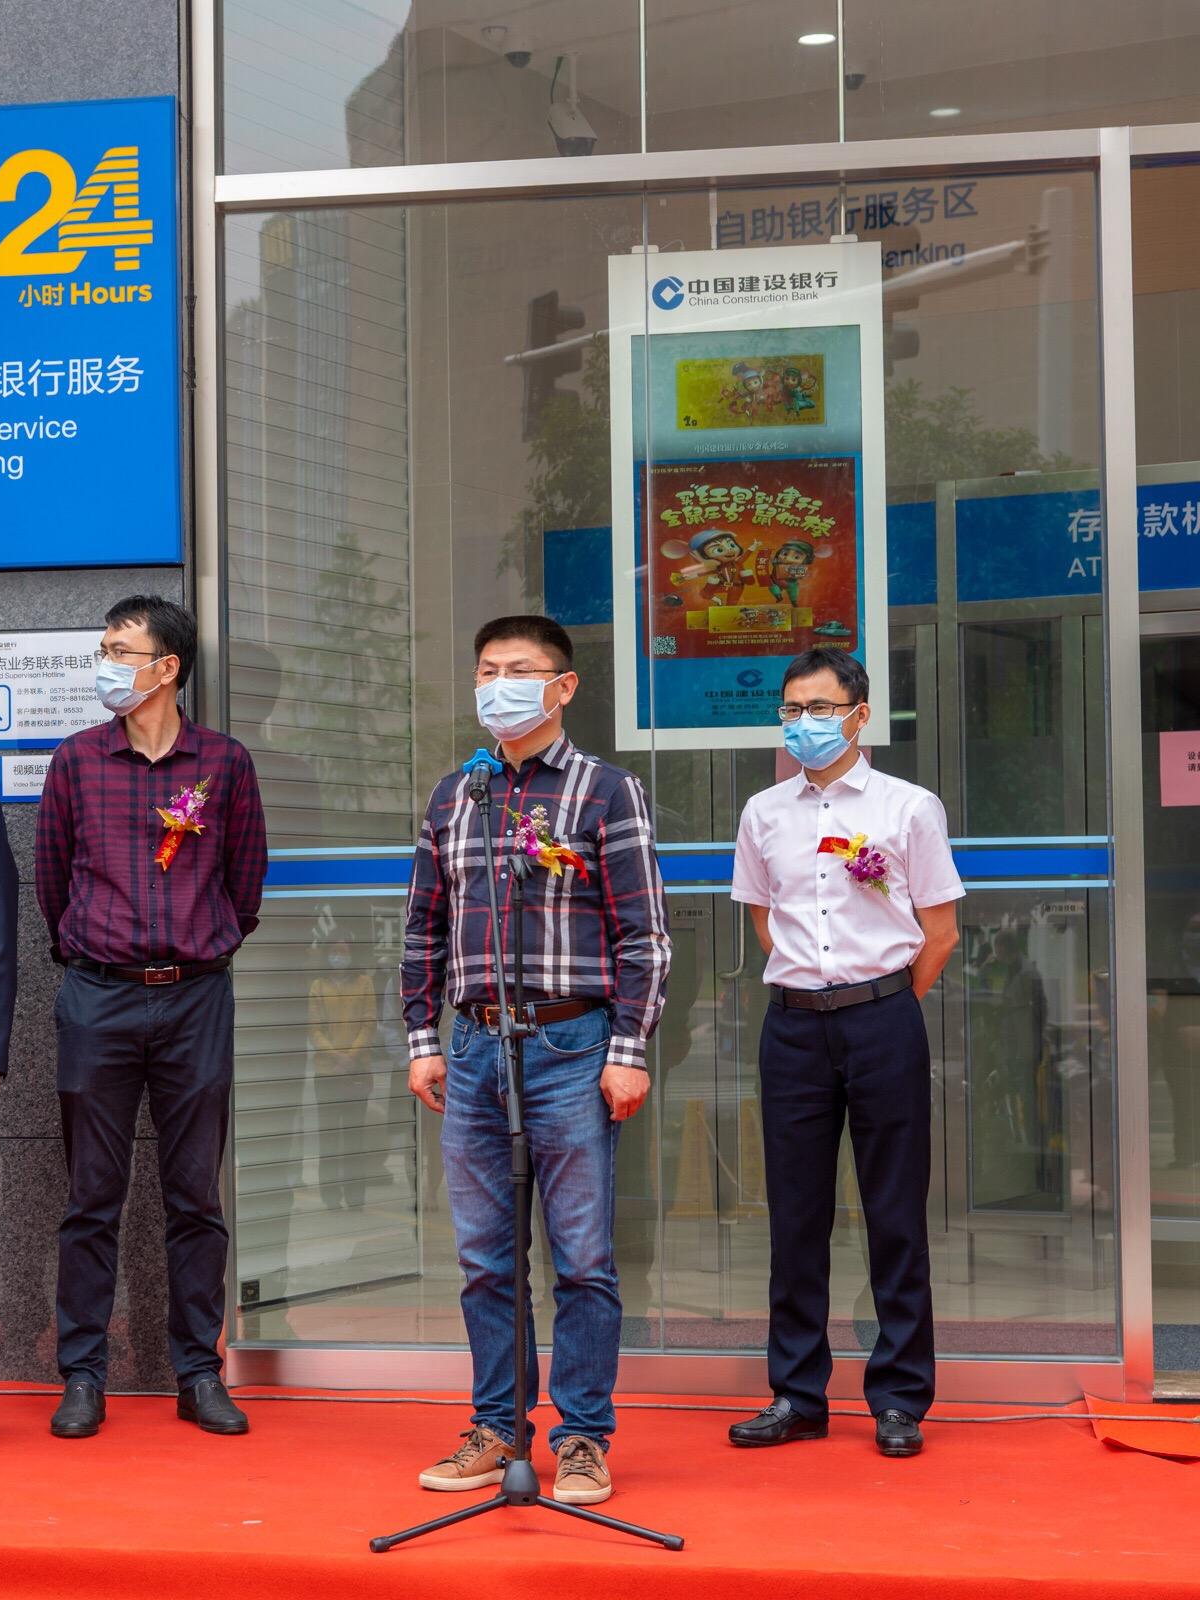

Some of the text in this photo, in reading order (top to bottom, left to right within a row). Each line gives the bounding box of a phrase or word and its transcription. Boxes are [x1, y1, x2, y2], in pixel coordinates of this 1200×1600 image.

[716, 182, 979, 248] 自助银行服务区
[881, 242, 966, 269] anking
[18, 282, 153, 307] 小时 Hours
[688, 271, 838, 295] 中国建设银行
[689, 291, 819, 306] China Construction Bank
[1067, 556, 1102, 578] AT
